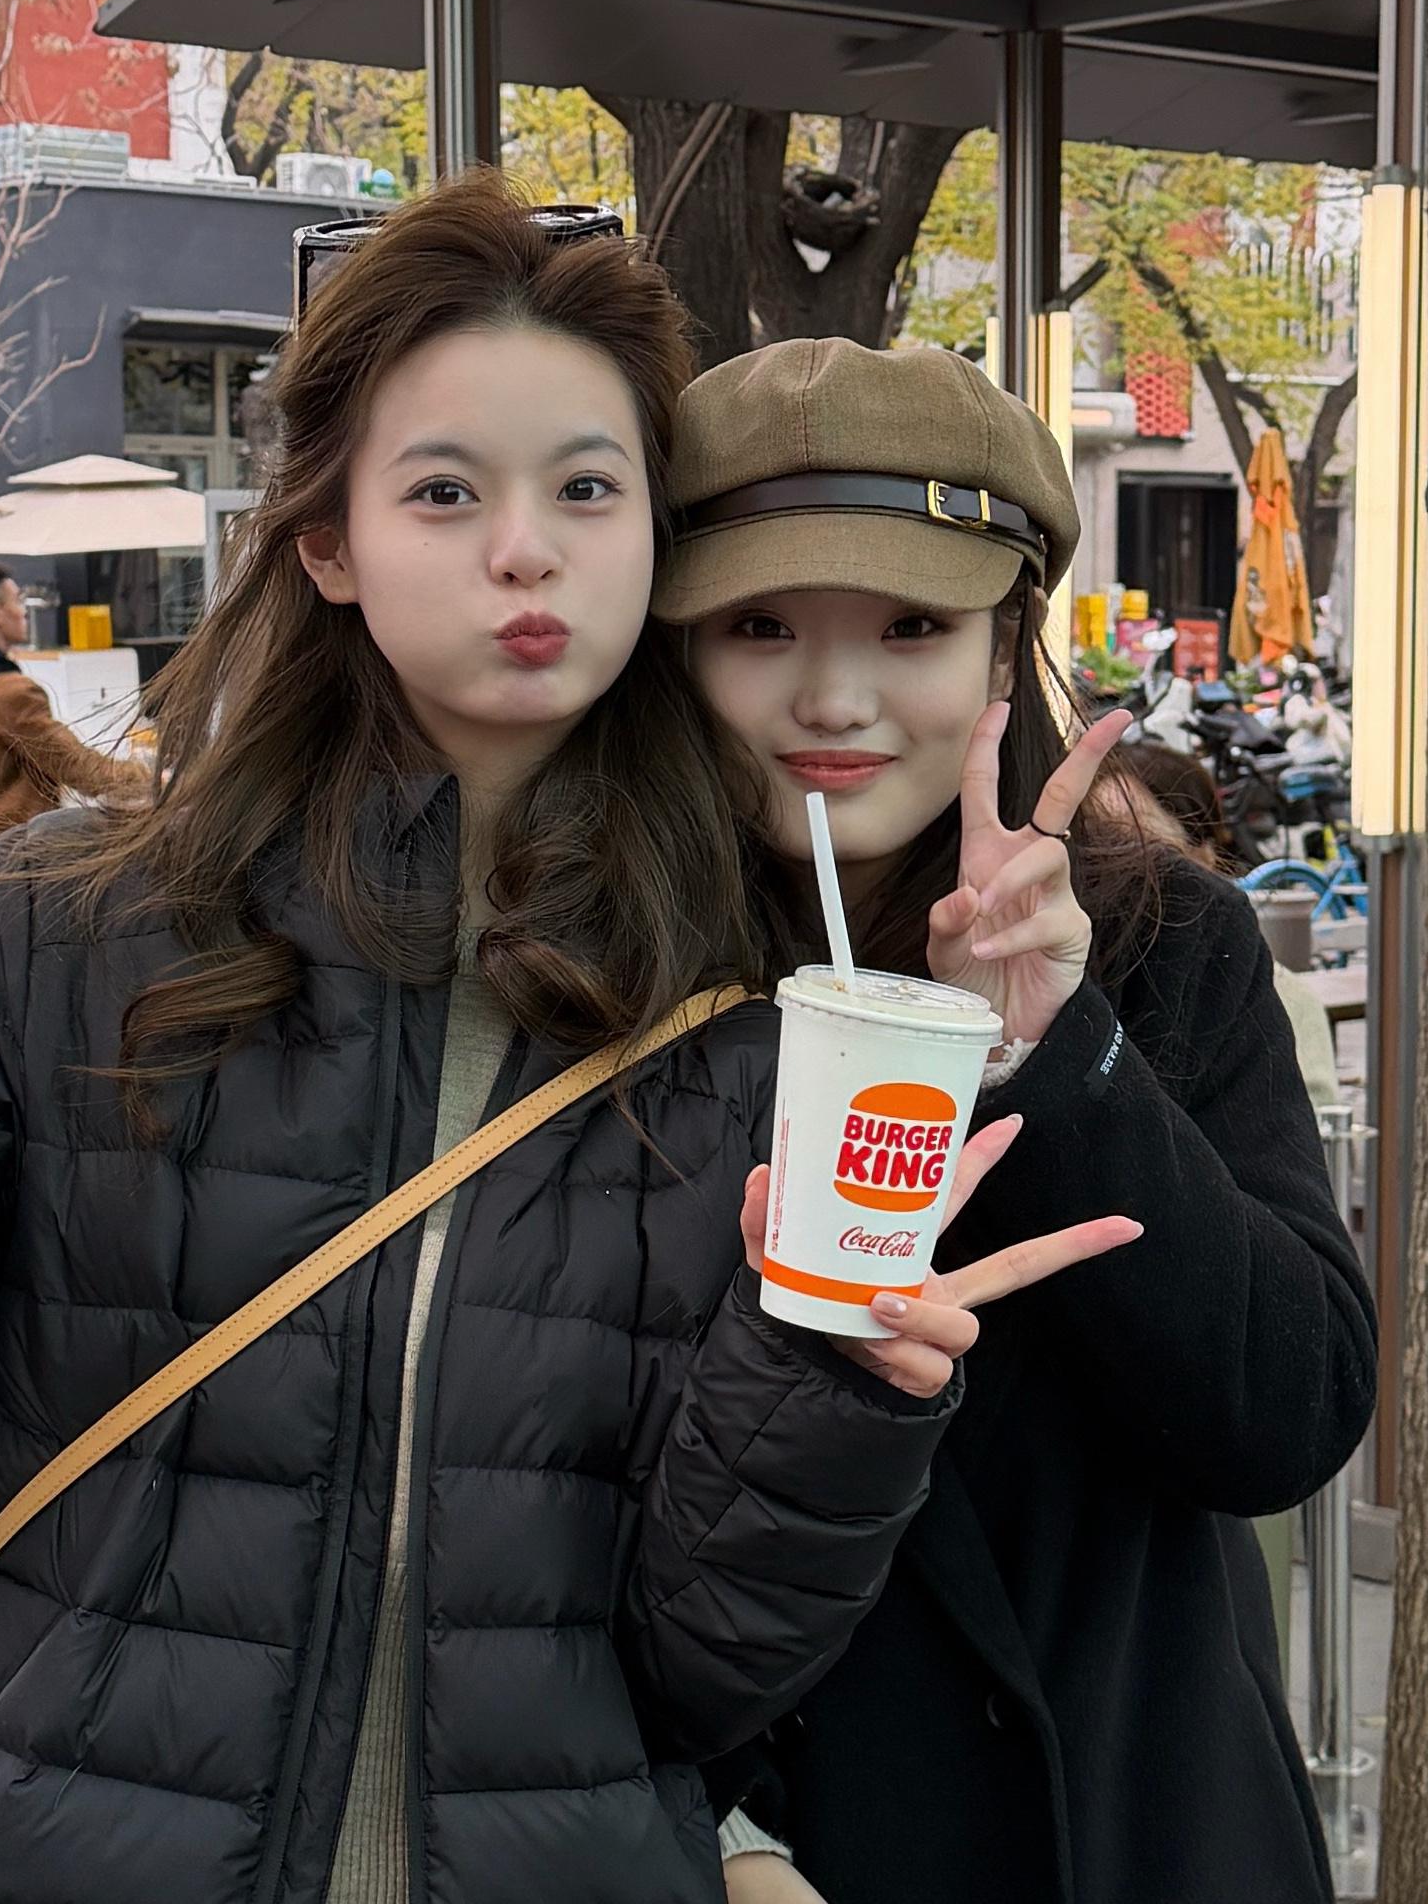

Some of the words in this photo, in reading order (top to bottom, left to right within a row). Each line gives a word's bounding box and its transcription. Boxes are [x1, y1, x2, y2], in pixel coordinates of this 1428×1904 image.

[843, 1114, 953, 1151] BURGER
[835, 1141, 947, 1189] KING
[838, 1226, 922, 1258] Coca-Cola
